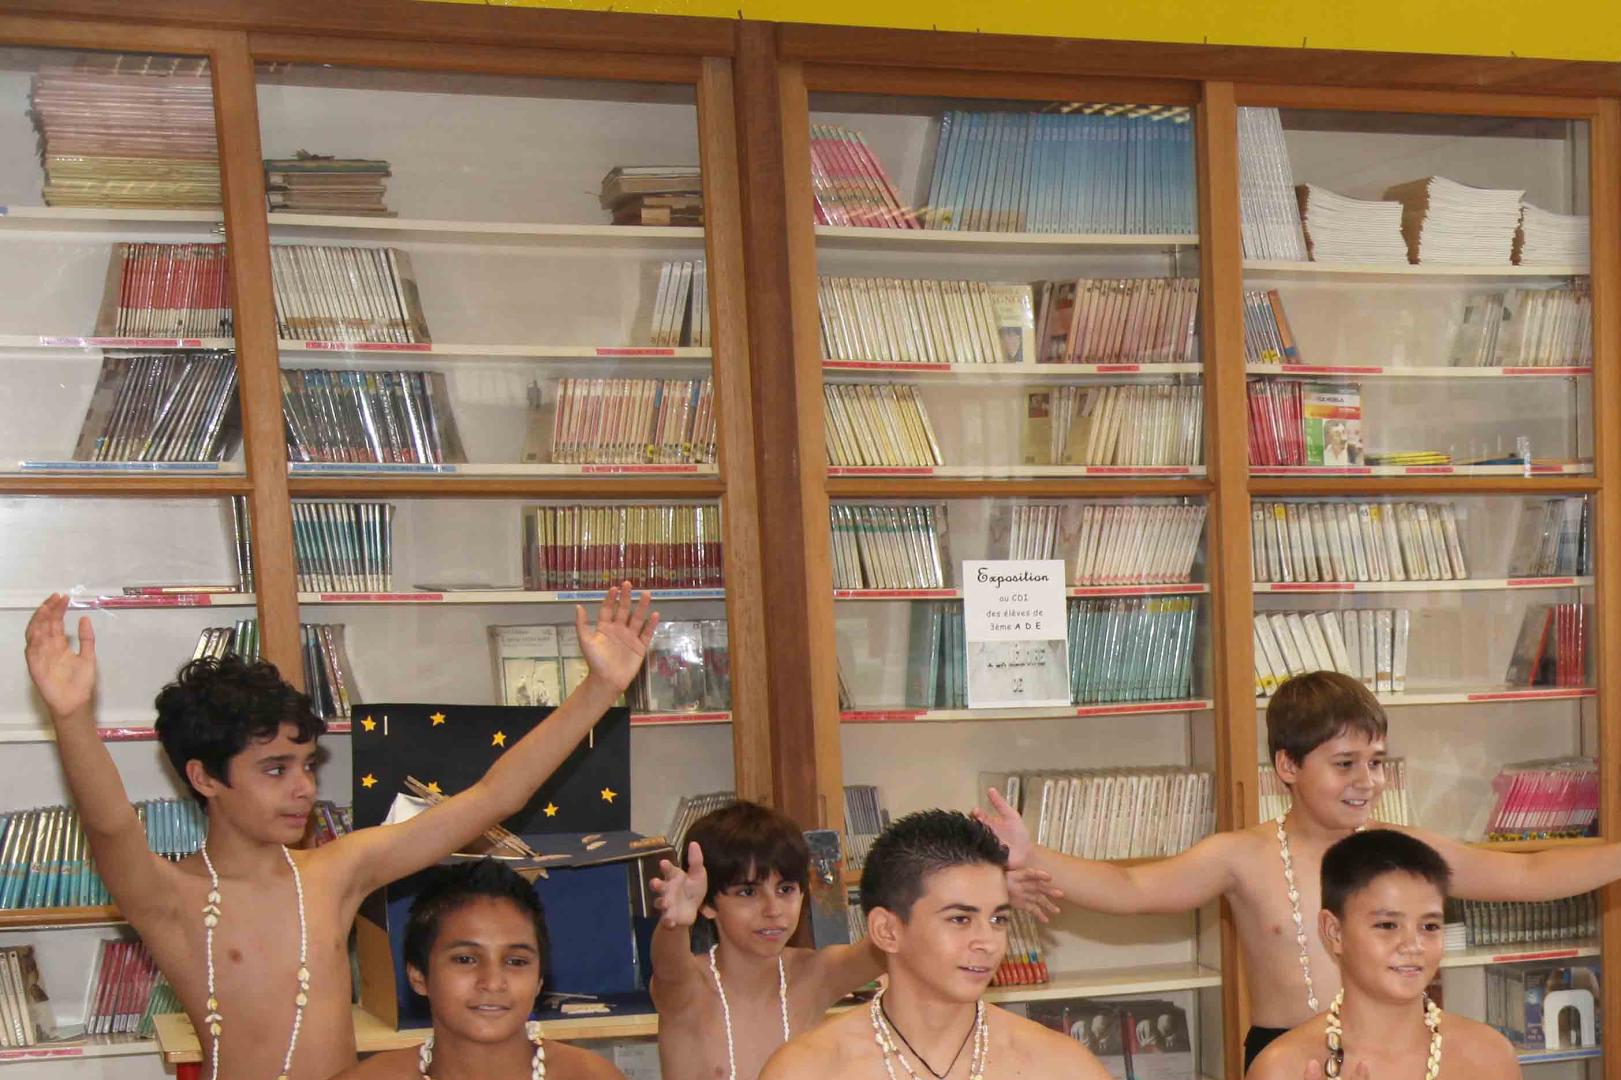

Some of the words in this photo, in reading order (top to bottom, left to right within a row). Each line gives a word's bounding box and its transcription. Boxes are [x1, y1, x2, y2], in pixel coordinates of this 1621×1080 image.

[977, 567, 1049, 589] Exposition
[1011, 593, 1029, 602] CDI
[986, 610, 1001, 618] des
[1032, 608, 1044, 617] de
[1025, 622, 1032, 630] D
[1035, 621, 1041, 630] E
